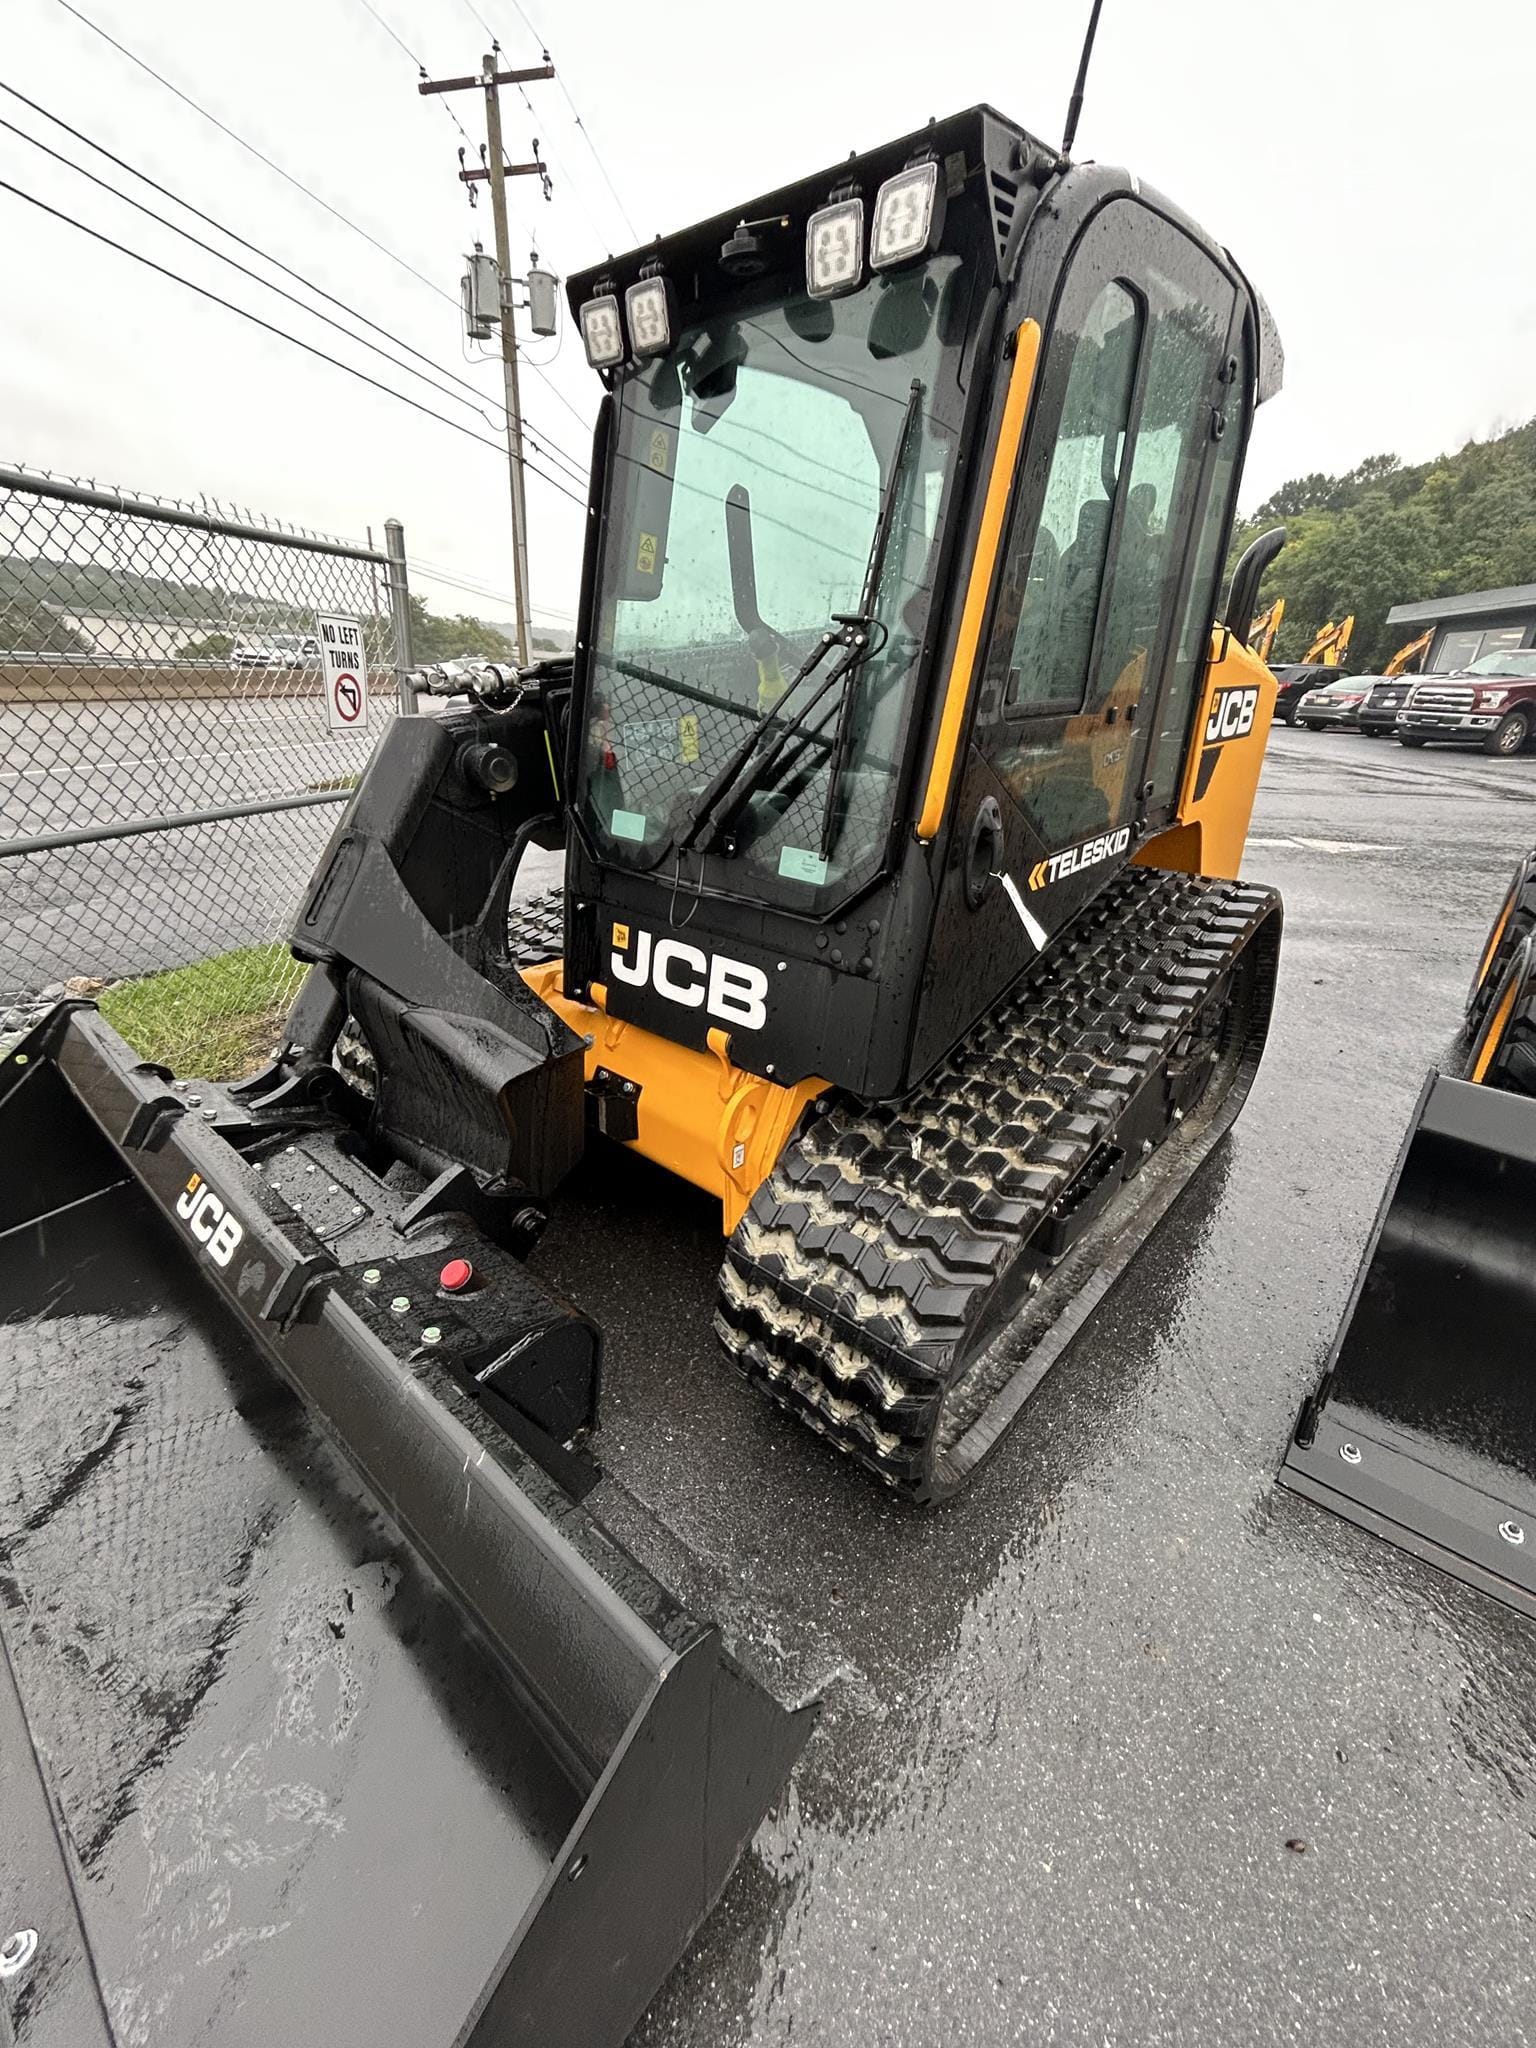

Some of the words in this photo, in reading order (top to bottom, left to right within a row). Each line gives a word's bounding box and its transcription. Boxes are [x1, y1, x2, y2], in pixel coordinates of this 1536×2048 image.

[322, 624, 336, 643] NO
[338, 626, 359, 646] LEFT
[329, 650, 360, 669] TURNS
[1206, 690, 1258, 741] JCB
[1048, 827, 1130, 883] TELESKID
[611, 930, 768, 1030] JCB
[176, 1182, 243, 1267] JCB
